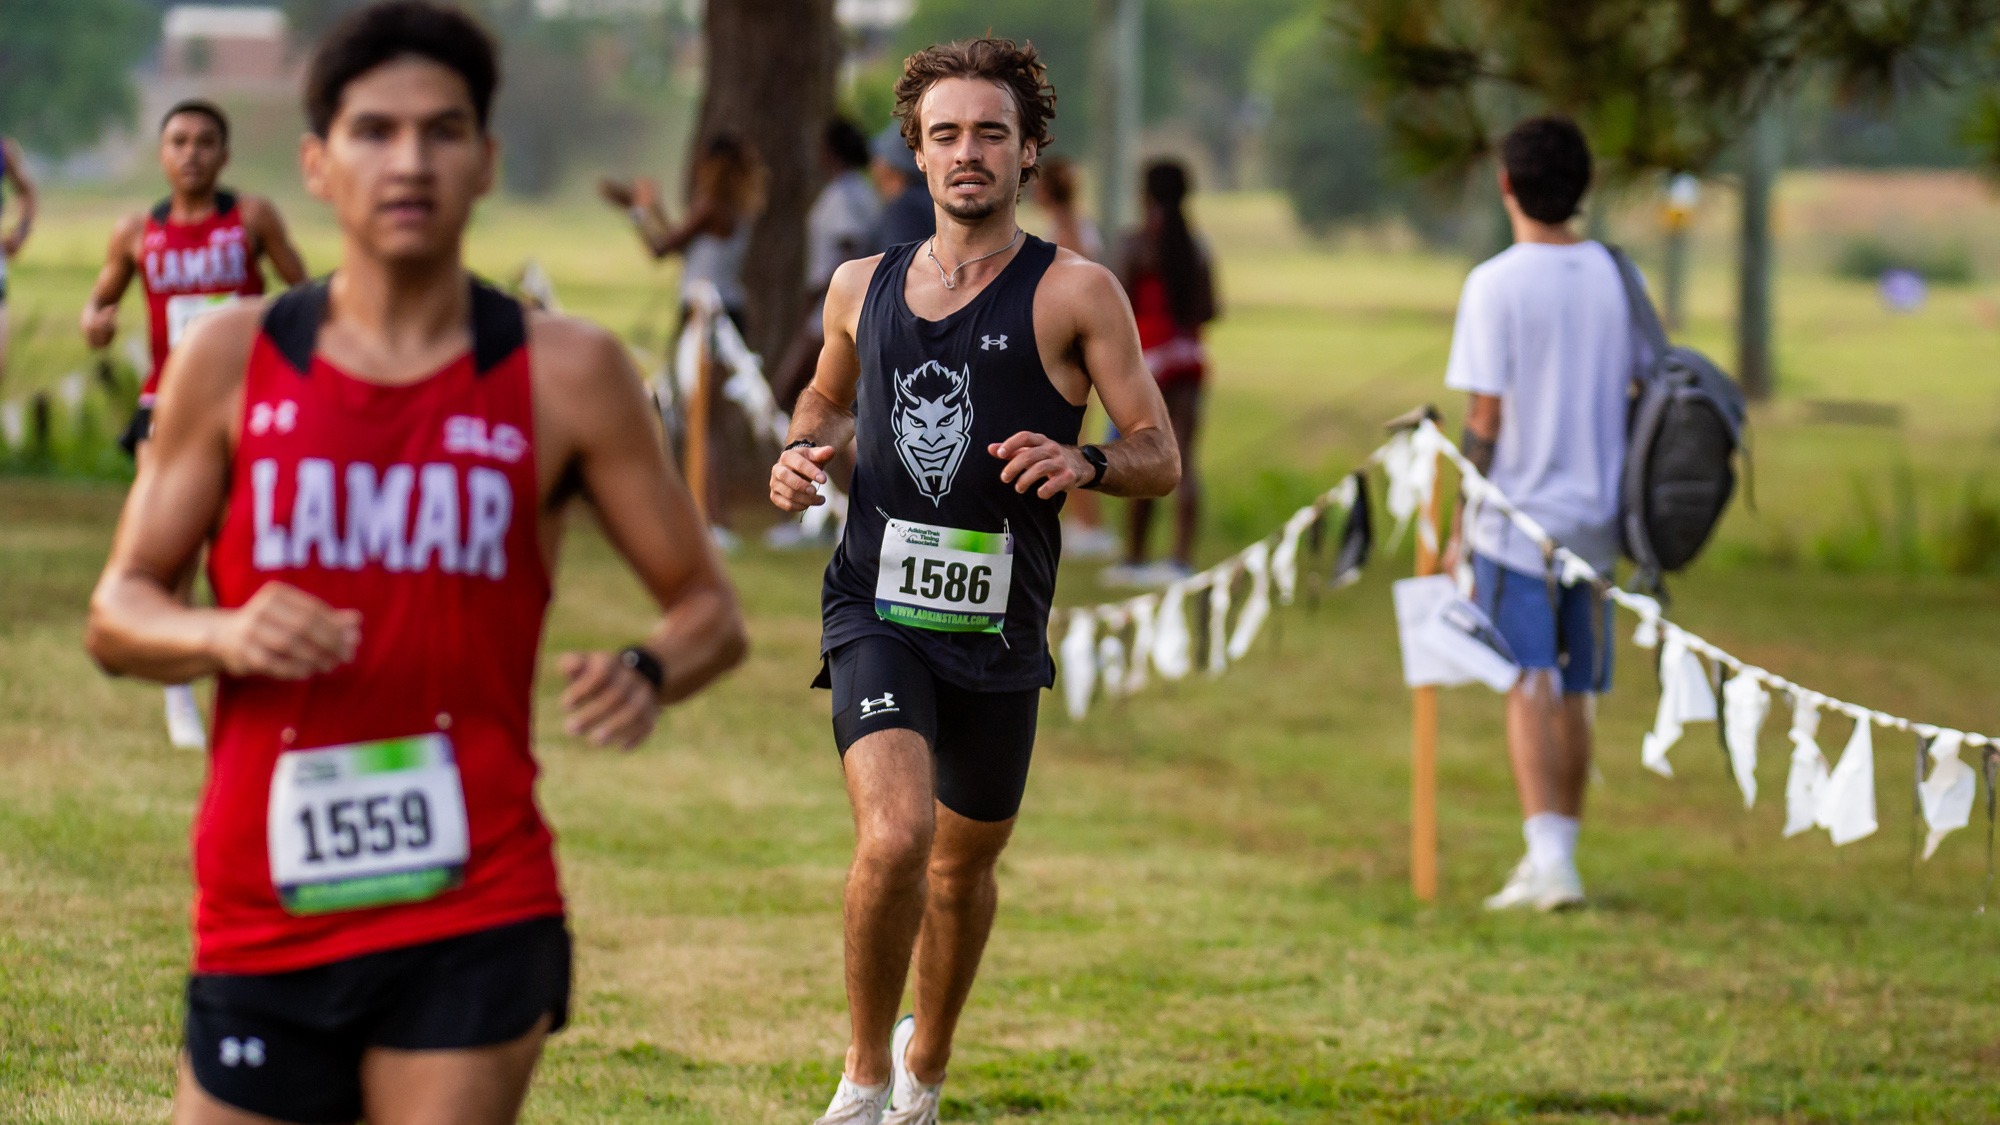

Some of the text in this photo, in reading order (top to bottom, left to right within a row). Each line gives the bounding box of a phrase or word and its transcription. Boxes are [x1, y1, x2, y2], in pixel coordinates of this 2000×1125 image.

[146, 243, 246, 291] LAMAR
[251, 457, 513, 580] LAMAR
[899, 555, 992, 604] 1586
[299, 789, 432, 863] 1559
